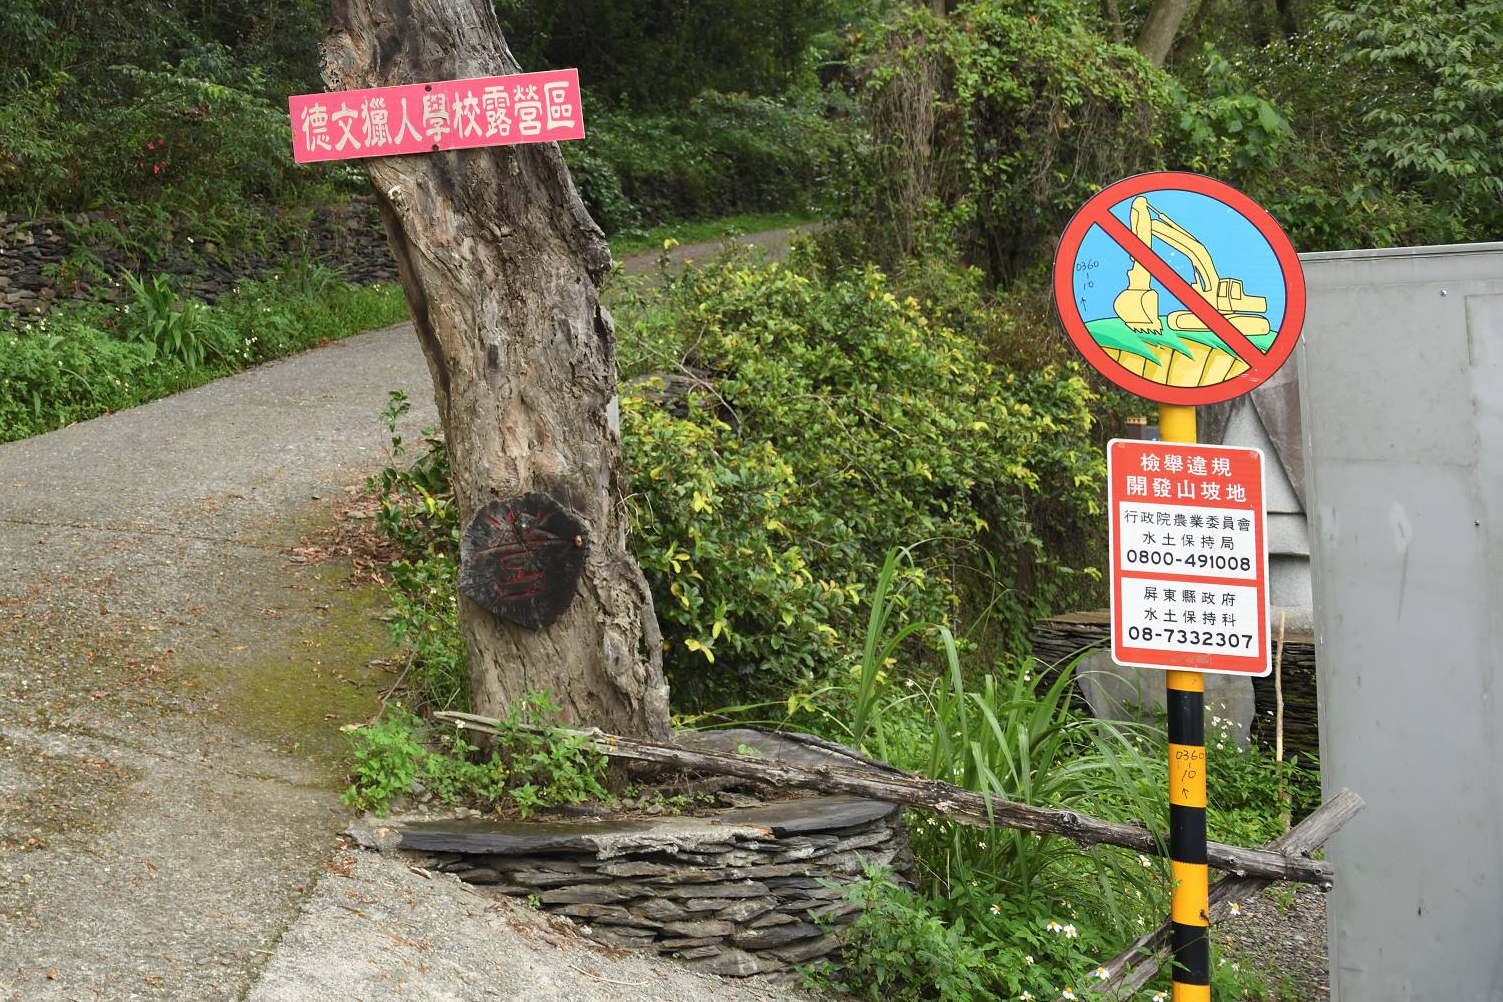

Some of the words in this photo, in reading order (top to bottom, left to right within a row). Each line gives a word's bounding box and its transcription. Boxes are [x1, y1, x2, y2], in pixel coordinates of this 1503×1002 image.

[301, 80, 576, 151] 德文獵人學校露營區
[1076, 258, 1099, 271] 0360
[1140, 453, 1232, 477] 檢舉違規
[1127, 476, 1246, 502] 開發山坡地
[1125, 509, 1250, 532] 行政院農業委員會
[1142, 532, 1235, 550] 水土保持局
[1127, 549, 1251, 571] 0800-491008
[1144, 586, 1236, 607] 屏東縣政府
[1144, 608, 1237, 627] 水土保持科
[1128, 626, 1253, 649] 08-7332307
